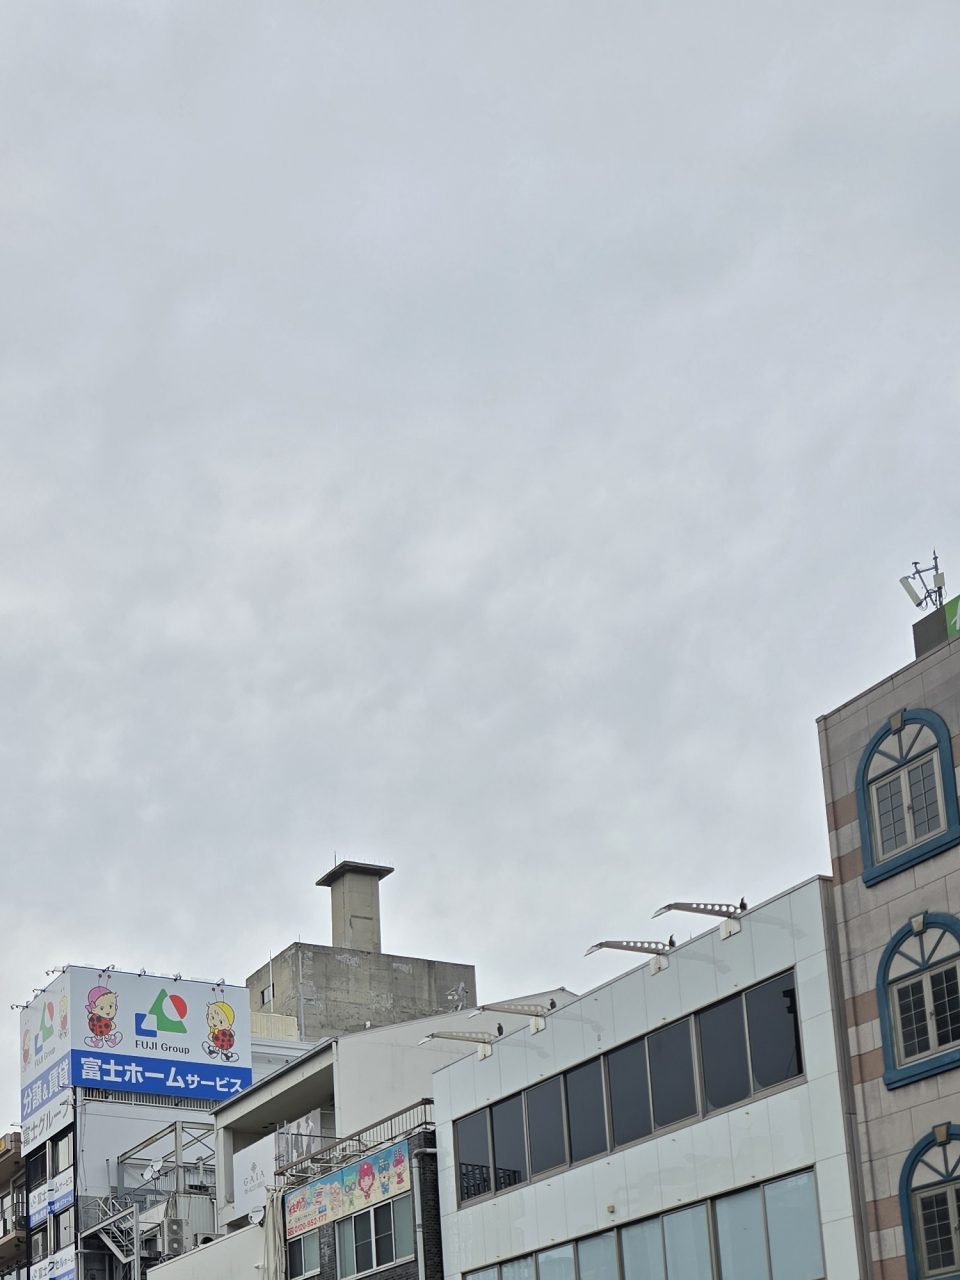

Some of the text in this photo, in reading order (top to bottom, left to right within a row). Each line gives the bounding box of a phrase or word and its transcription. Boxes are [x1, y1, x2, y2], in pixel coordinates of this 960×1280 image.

[135, 1039, 190, 1055] FUJI Group
[80, 1057, 243, 1093] 富士ホームサービス
